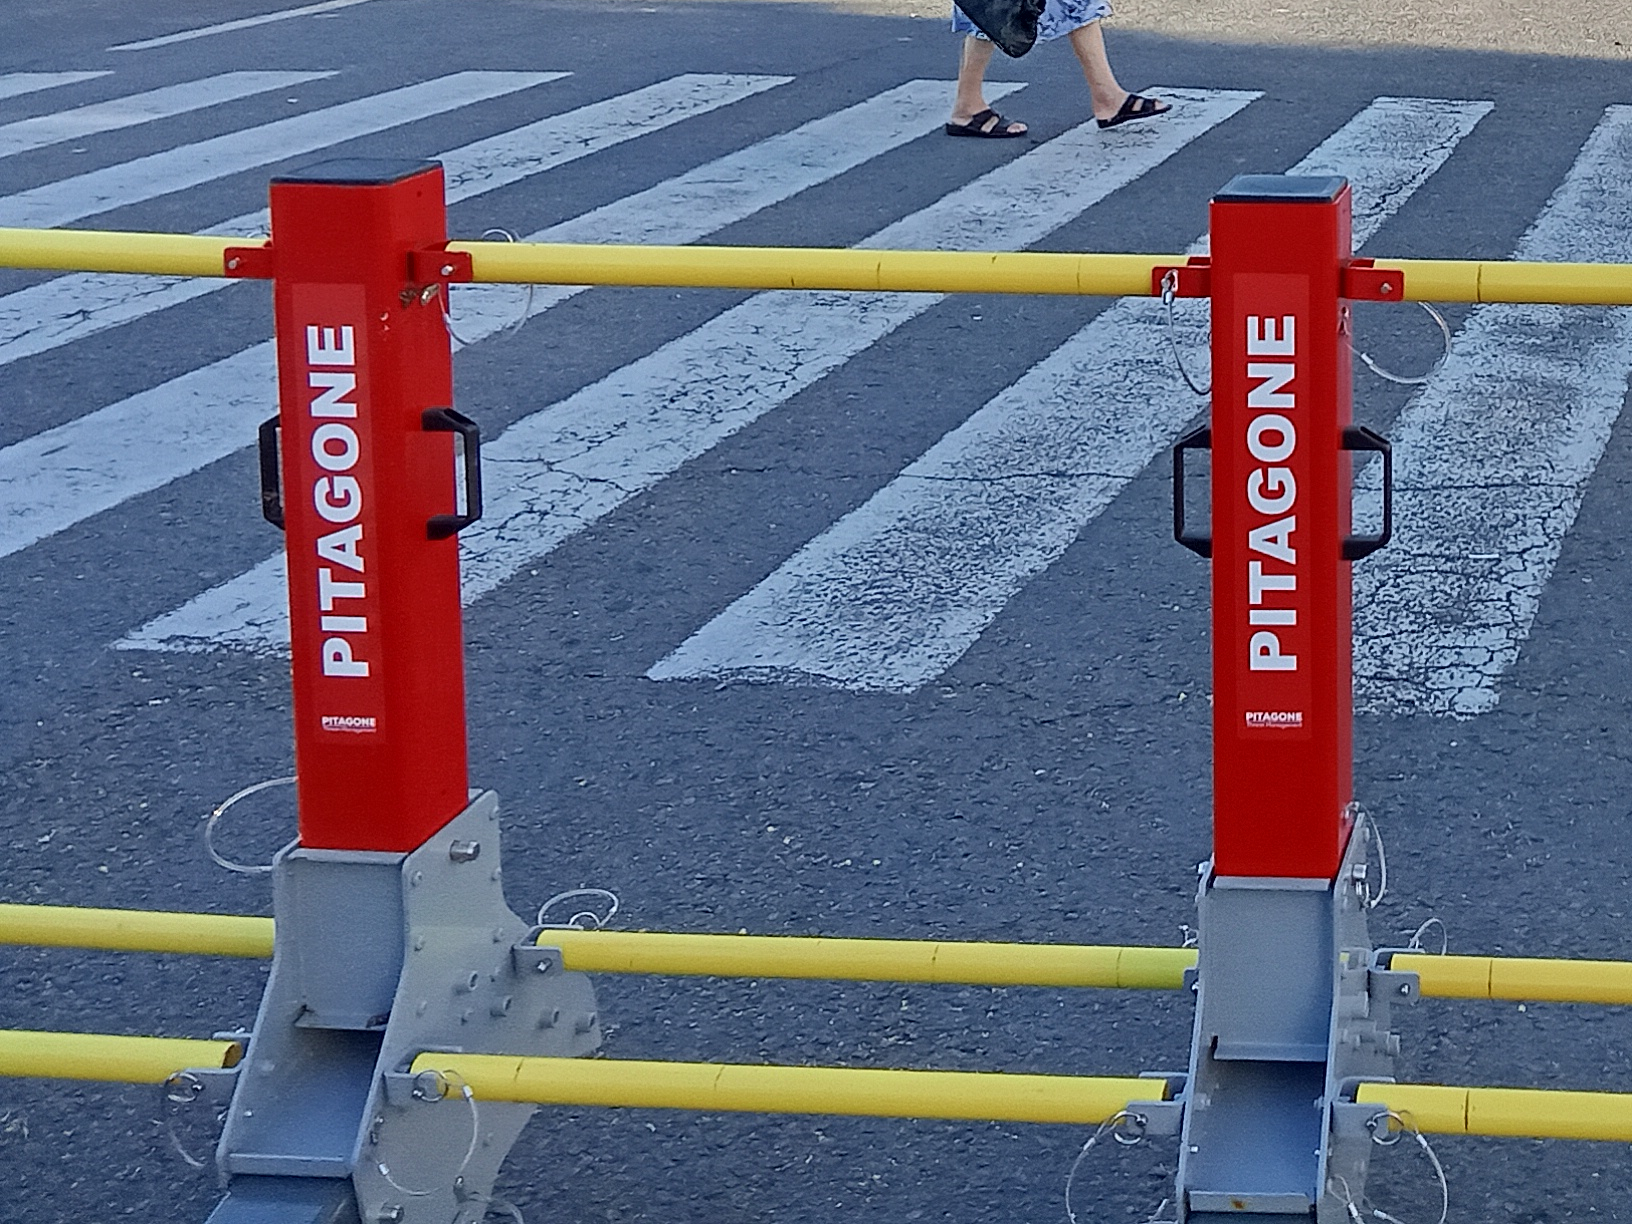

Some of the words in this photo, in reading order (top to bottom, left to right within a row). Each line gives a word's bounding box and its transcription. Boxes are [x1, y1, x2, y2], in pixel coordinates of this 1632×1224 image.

[306, 325, 370, 677] PITAGONE
[1246, 315, 1297, 671] PITAGONE
[321, 716, 376, 727] PITAGONE
[1245, 711, 1302, 722] PITAGONE
